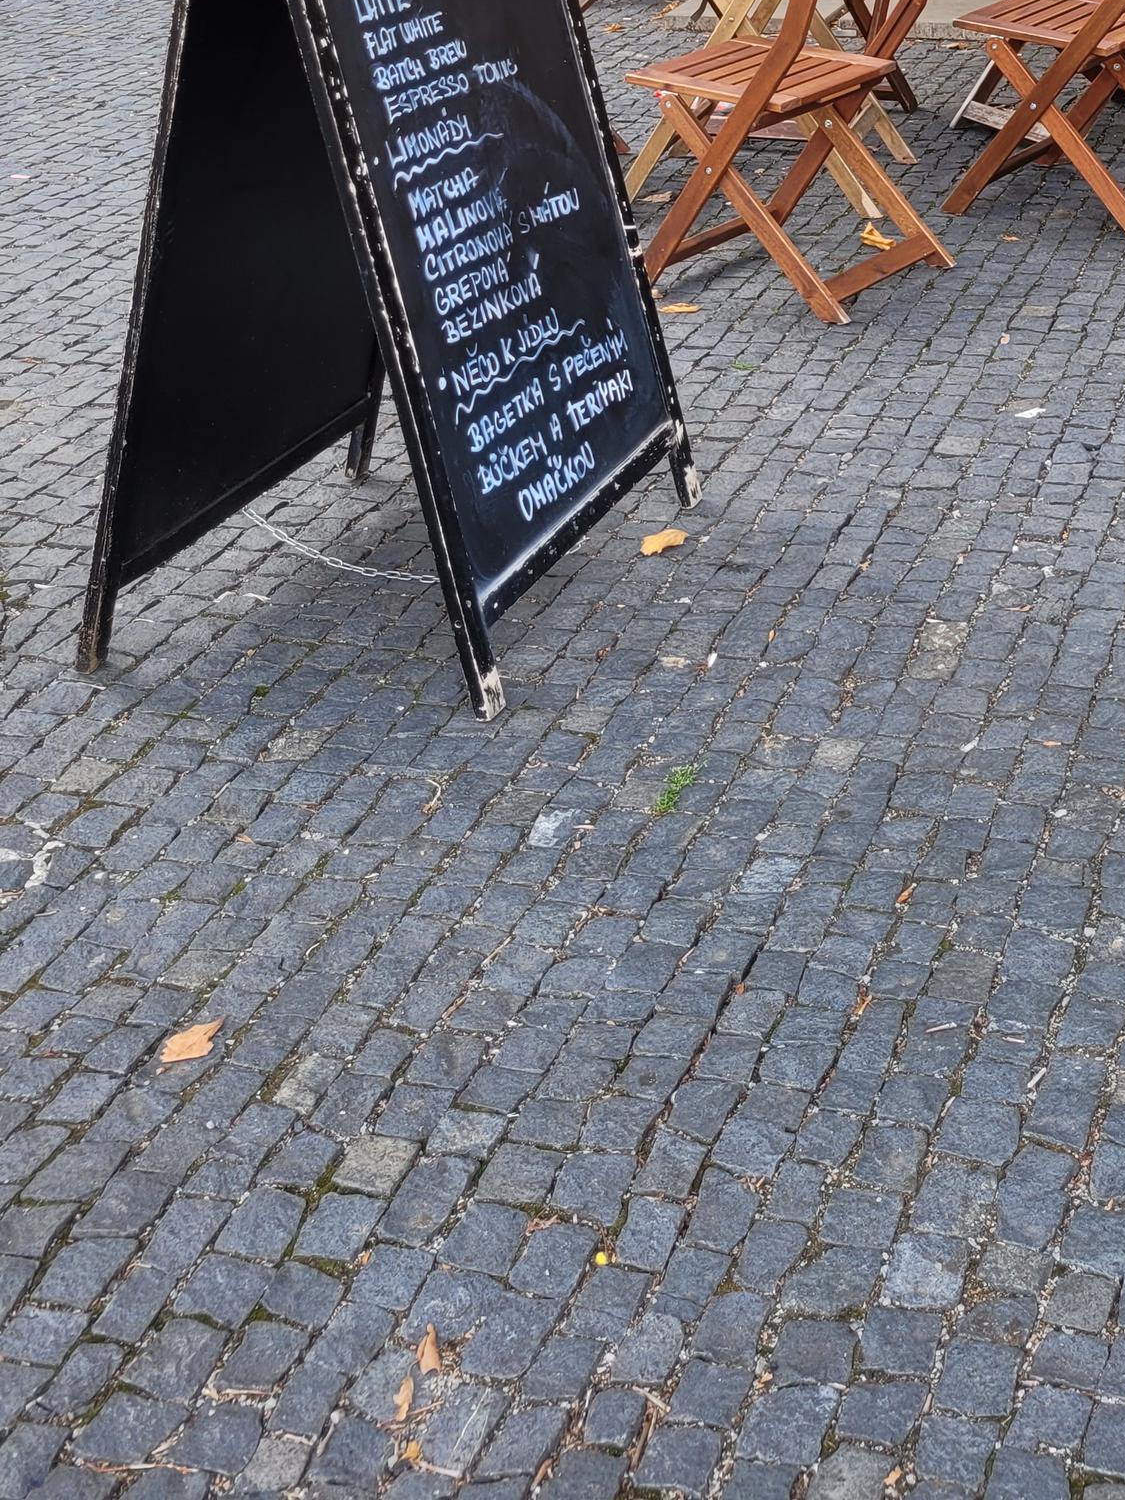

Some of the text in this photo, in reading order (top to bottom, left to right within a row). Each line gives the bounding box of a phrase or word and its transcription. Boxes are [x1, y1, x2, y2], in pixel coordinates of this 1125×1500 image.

[364, 11, 444, 59] FLAT WHITE
[373, 39, 468, 90] BATCH BREW
[384, 71, 470, 124] ESPRESSO
[407, 167, 480, 216] MATCHA
[424, 209, 514, 281] CITRONOVÁ
[529, 182, 580, 226] MÁTOU
[435, 253, 511, 315] GREPOVÁ
[442, 254, 543, 344] BEZINKOVÁ
[452, 308, 560, 397] NĚCO K JÍDLU
[467, 319, 629, 453] BAGETKA S PEČENÝM
[478, 440, 547, 495] BŮČKEM
[551, 418, 562, 440] A
[518, 441, 596, 521] OMÁČKOU
